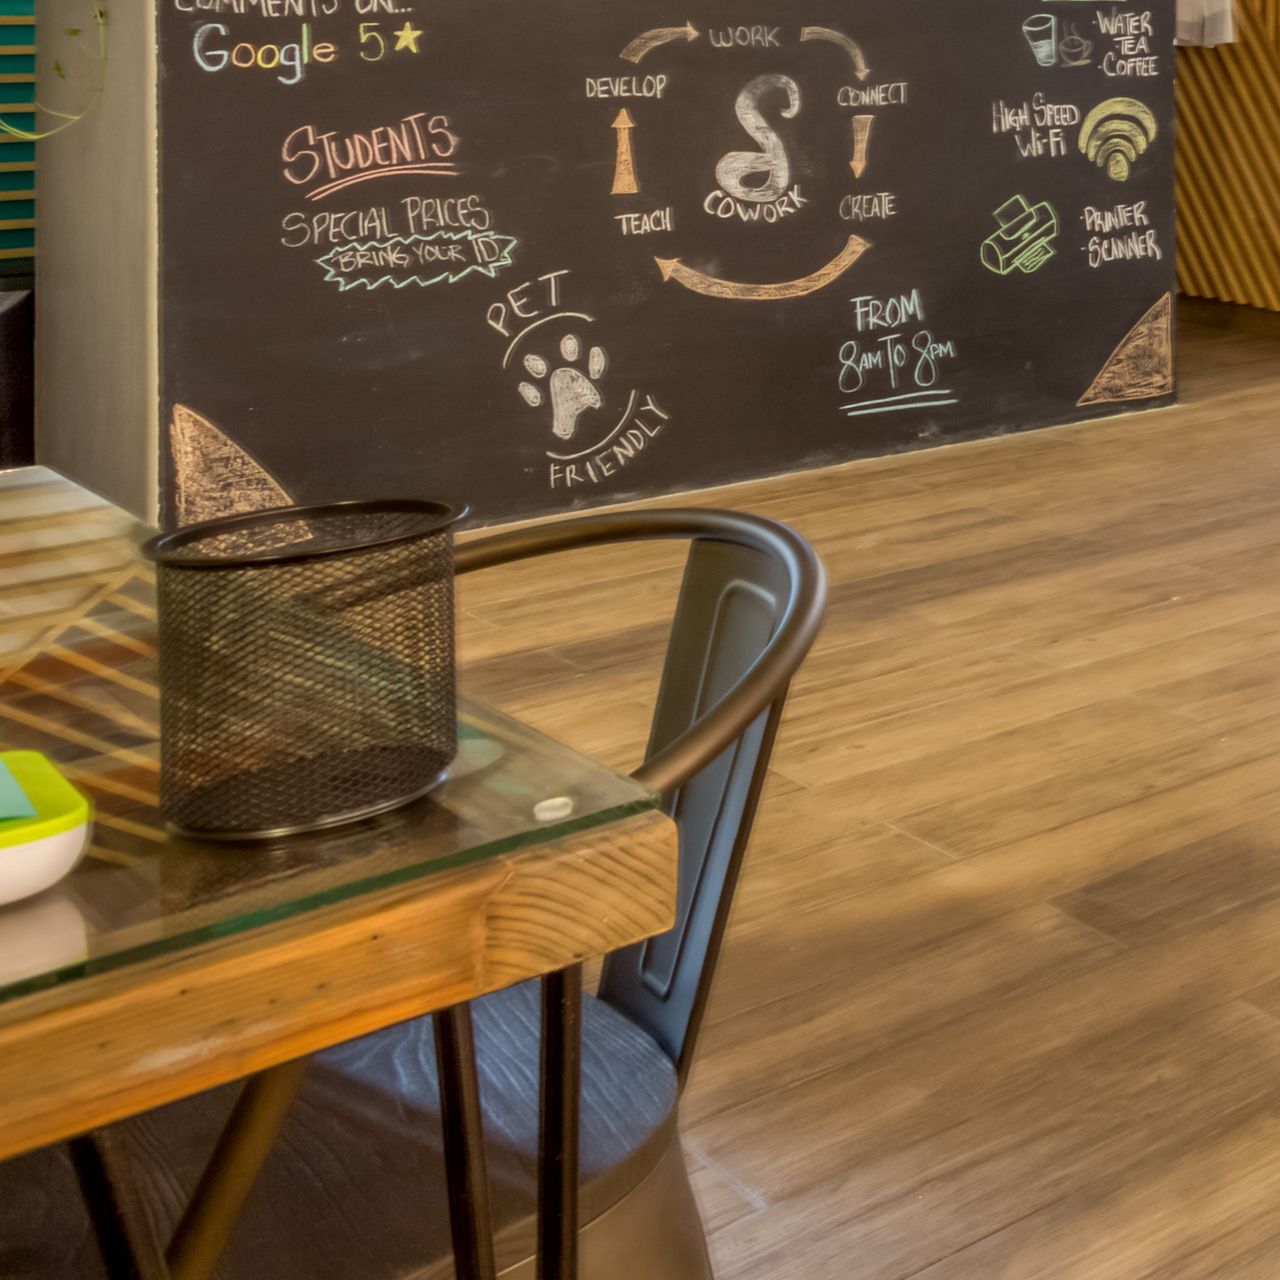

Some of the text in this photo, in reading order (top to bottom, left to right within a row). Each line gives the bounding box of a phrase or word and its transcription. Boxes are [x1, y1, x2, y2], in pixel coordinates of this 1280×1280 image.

[193, 22, 385, 85] Google 5
[709, 26, 782, 47] WORK
[586, 74, 668, 99] DEVELOP
[837, 82, 908, 107] CONNECT
[992, 92, 1081, 134] HIGH SPEED
[281, 112, 460, 185] STUDENTS
[281, 195, 490, 248] SPECIAL PRICES
[614, 207, 674, 235] TEACH
[703, 184, 809, 223] COWORK
[839, 192, 897, 221] CREATE
[331, 237, 500, 273] BRING YOUR ID
[487, 270, 571, 337] PET
[850, 288, 924, 332] FROM
[550, 394, 670, 489] FRIENDLY
